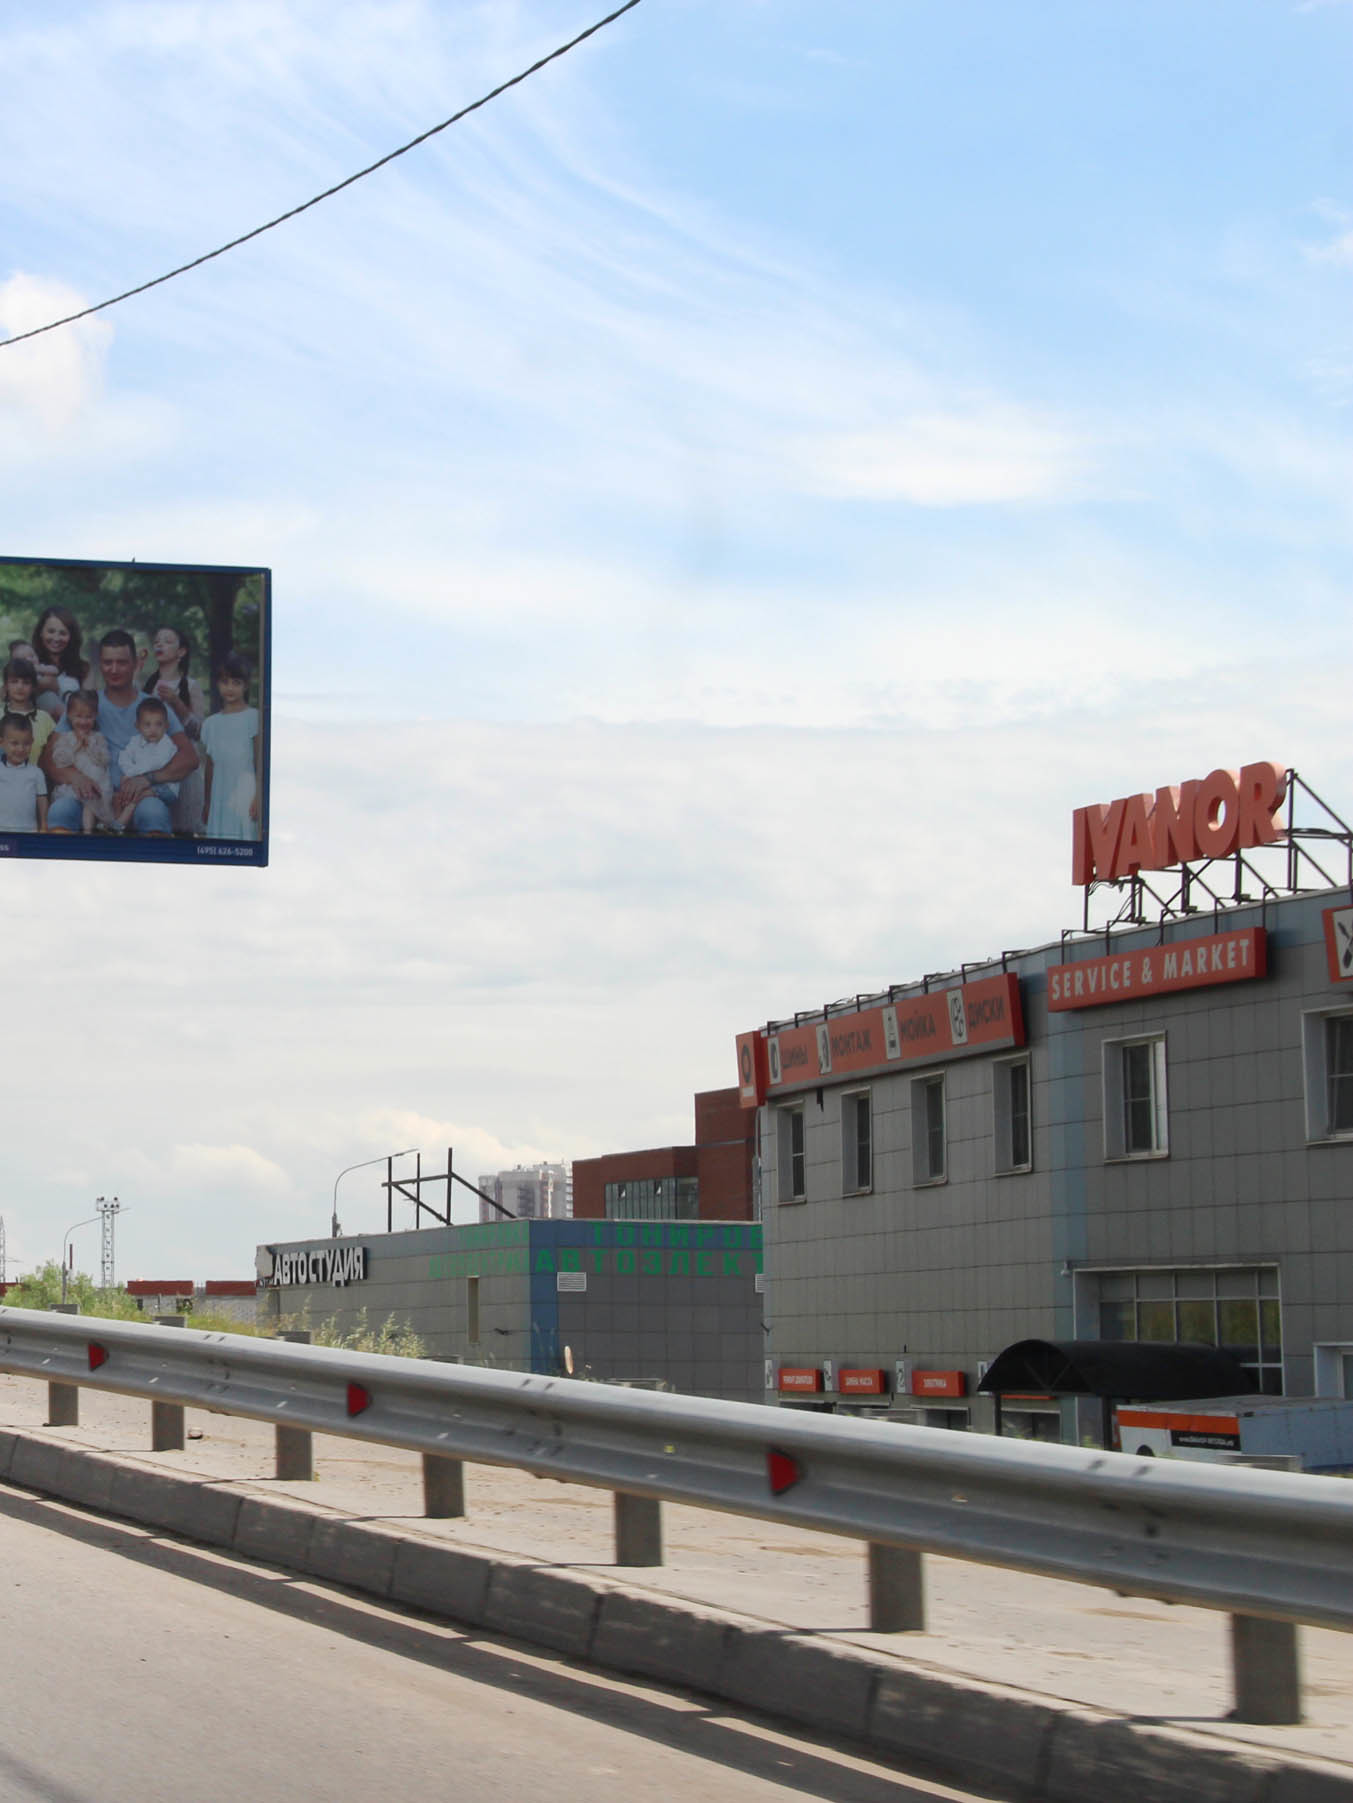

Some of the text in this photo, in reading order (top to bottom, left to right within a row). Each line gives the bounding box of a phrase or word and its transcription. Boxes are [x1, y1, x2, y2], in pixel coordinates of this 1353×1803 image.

[1072, 761, 1290, 886] IVANOR
[1051, 938, 1251, 1001] SERVICE & MARKET
[900, 1010, 937, 1041] МОЙКА
